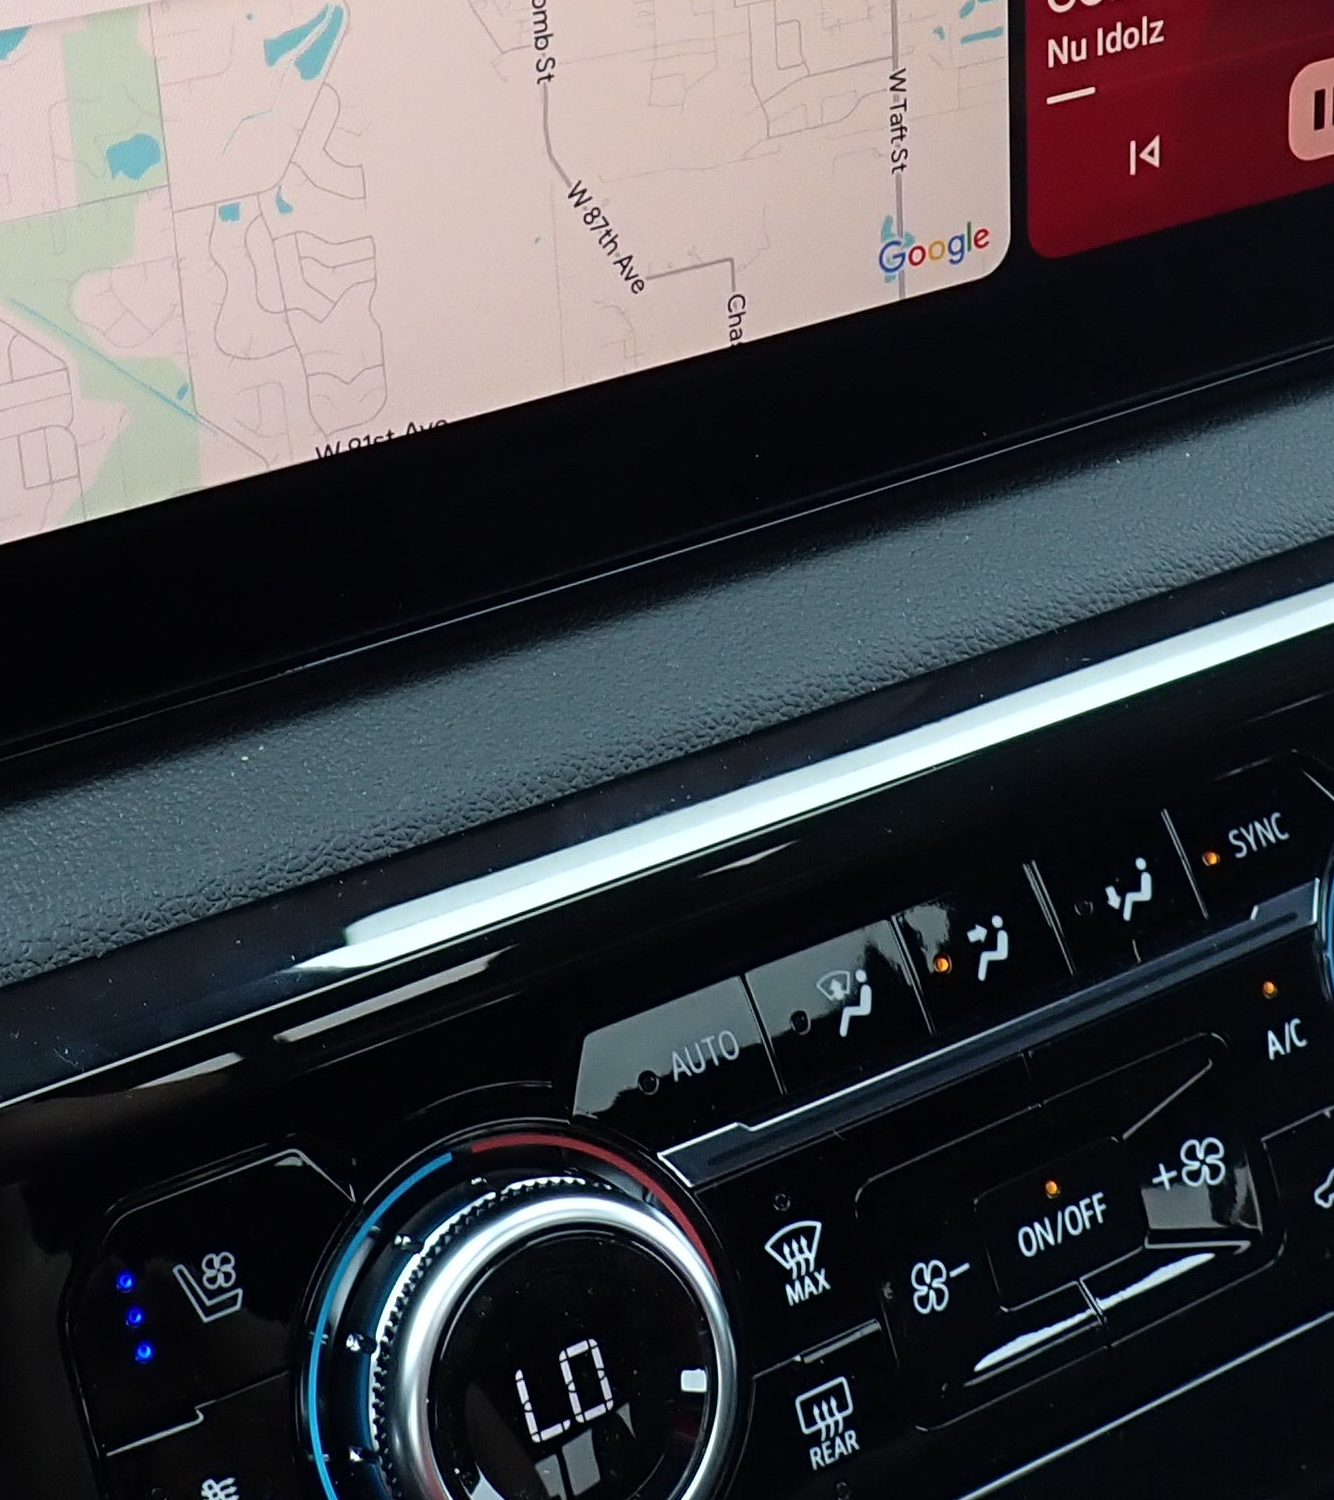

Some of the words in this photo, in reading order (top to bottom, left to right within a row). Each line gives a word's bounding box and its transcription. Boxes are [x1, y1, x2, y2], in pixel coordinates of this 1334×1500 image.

[1047, 35, 1087, 68] Nu
[1097, 15, 1165, 56] Idolz
[535, 56, 556, 85] St
[889, 67, 907, 92] W
[889, 97, 908, 144] Taft
[891, 148, 908, 175] St
[567, 179, 593, 208] W
[583, 206, 619, 257] 87th
[612, 254, 645, 295] Ave
[878, 221, 990, 273] Google
[727, 294, 746, 346] Cha
[1228, 811, 1290, 858] SYNC
[671, 1030, 740, 1082] AUTO
[1267, 1018, 1308, 1060] A/C
[1017, 1191, 1107, 1257] ON/OFF
[785, 1278, 831, 1306] MAX
[514, 1338, 614, 1443] LO
[809, 1429, 860, 1470] REAR
